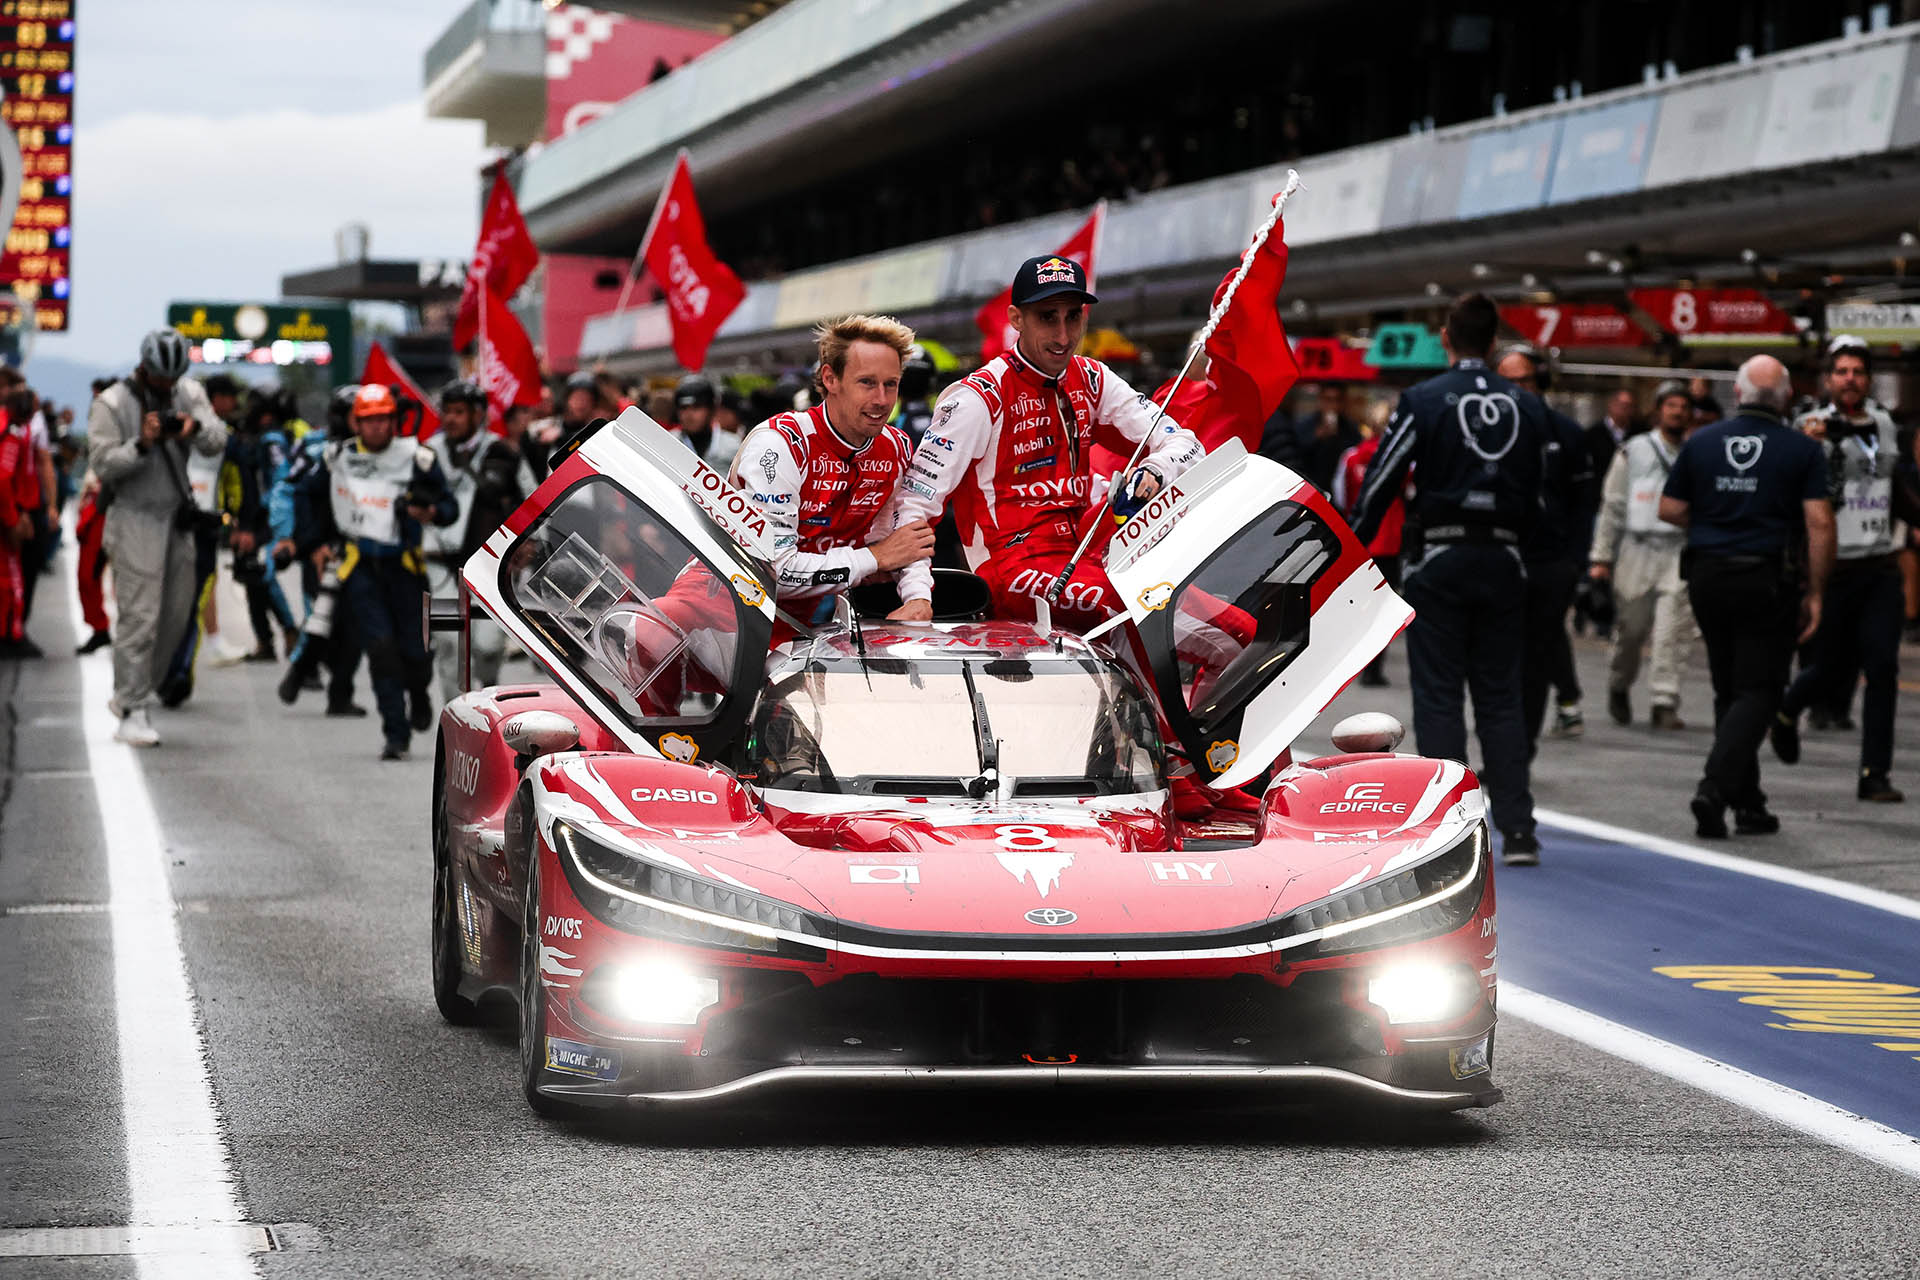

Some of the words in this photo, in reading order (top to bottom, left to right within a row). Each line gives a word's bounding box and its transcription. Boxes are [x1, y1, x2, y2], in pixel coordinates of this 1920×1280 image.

[1037, 272, 1058, 285] Red
[1058, 272, 1076, 284] Bull
[1671, 291, 1697, 332] 8
[1535, 307, 1561, 346] 7
[1013, 415, 1051, 434] AISIN
[1013, 437, 1043, 456] Mobil
[1011, 475, 1089, 498] TOYOT
[691, 460, 768, 538] TOYOTA
[850, 491, 884, 506] WEC
[1115, 484, 1185, 548] TOYOTA
[871, 635, 1050, 648] DENSO
[452, 750, 480, 797] DENSO
[630, 787, 718, 806] CASIO
[1319, 801, 1408, 814] EDIFICE
[993, 824, 1059, 851] 8
[1151, 861, 1218, 881] HY
[559, 1050, 612, 1070] MICHEIN
